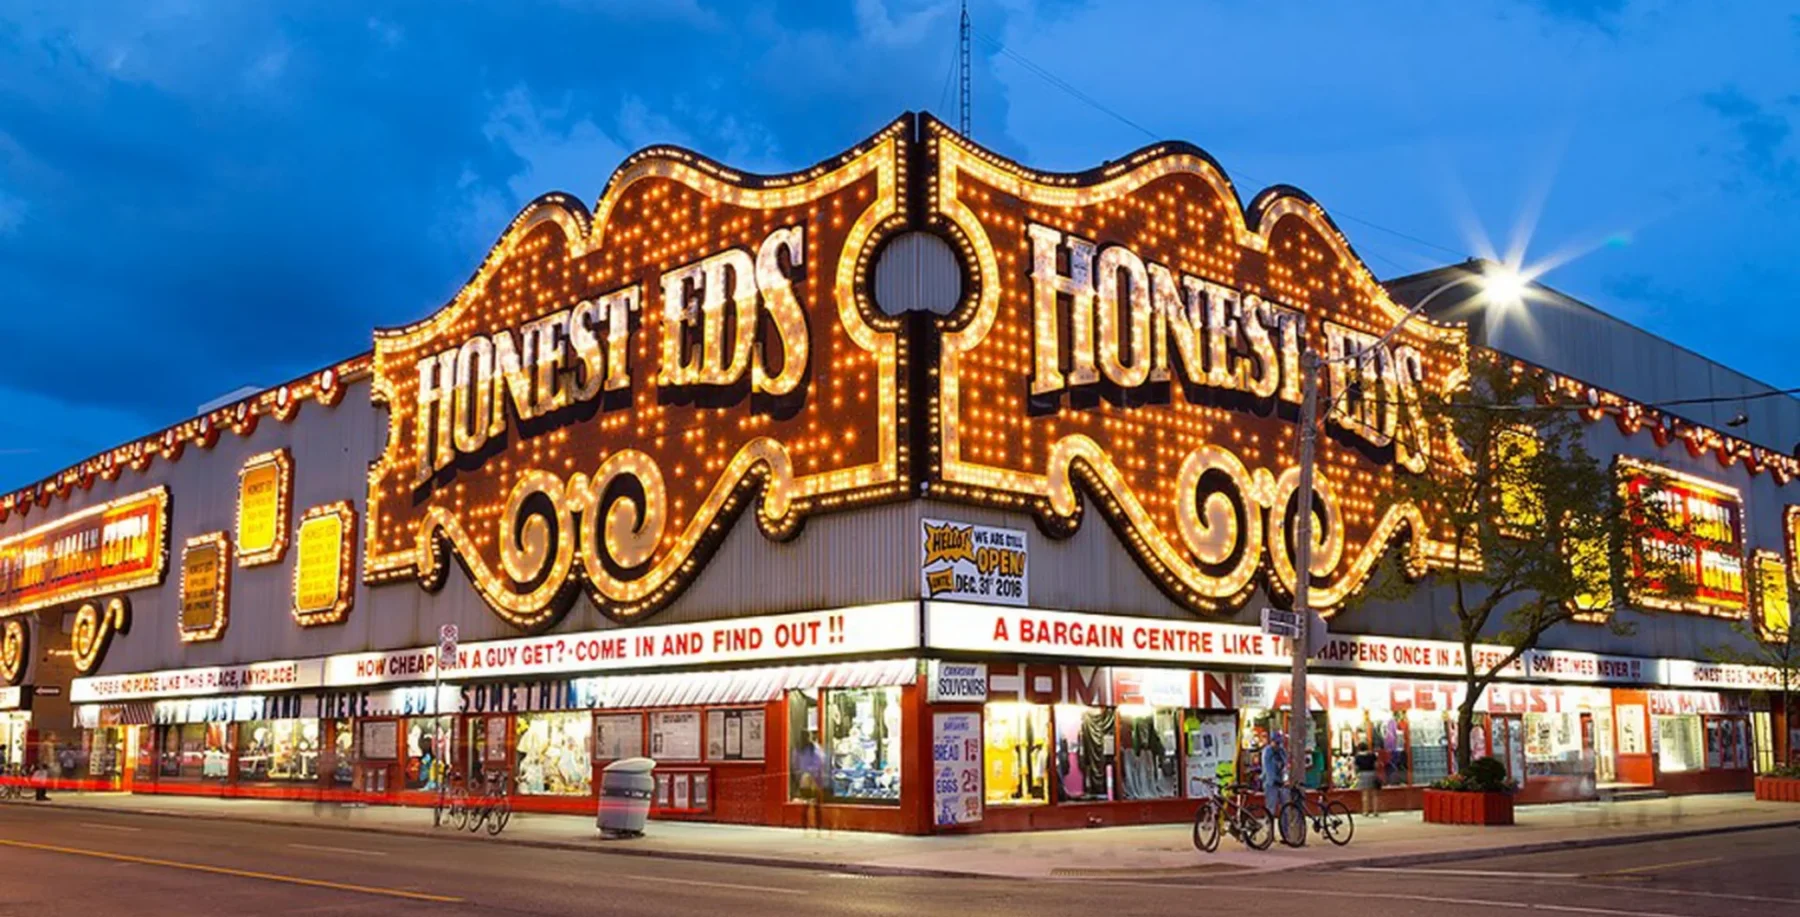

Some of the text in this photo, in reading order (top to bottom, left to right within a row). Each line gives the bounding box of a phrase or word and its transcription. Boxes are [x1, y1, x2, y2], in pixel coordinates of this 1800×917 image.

[411, 225, 809, 491] HONEST EDS
[1029, 223, 1431, 473] HONEST EDS
[933, 532, 969, 551] HELLO!
[974, 531, 988, 545] WE
[990, 532, 1004, 546] ARE
[976, 547, 1026, 577] OPEN!
[996, 578, 1022, 598] 2016
[357, 658, 385, 678] HOW
[389, 653, 434, 675] CHEAP
[472, 651, 483, 668] A
[486, 646, 518, 668] GUY
[576, 637, 626, 661] COME
[635, 636, 655, 658] IN
[662, 632, 704, 656] AND
[713, 627, 763, 653] FIND
[775, 621, 821, 648] OUT
[993, 617, 1010, 642] A
[1020, 618, 1124, 648] BARGAIN
[1133, 627, 1213, 654] CENTRE
[1222, 633, 1264, 655] LIKE
[1394, 645, 1431, 665] ONCE
[1437, 650, 1449, 666] IN
[1454, 650, 1463, 667] A
[1596, 660, 1628, 677] NEVER
[121, 679, 132, 692] NO
[134, 677, 159, 692] PLACE
[938, 678, 985, 696] SOUVENIRS
[1189, 668, 1233, 709] IN
[1272, 672, 1358, 711] AND
[1487, 686, 1564, 713] LOST
[203, 700, 237, 722] JUST
[251, 695, 301, 720] STAND
[935, 743, 959, 761] BREAD
[936, 779, 959, 794] EGGS
